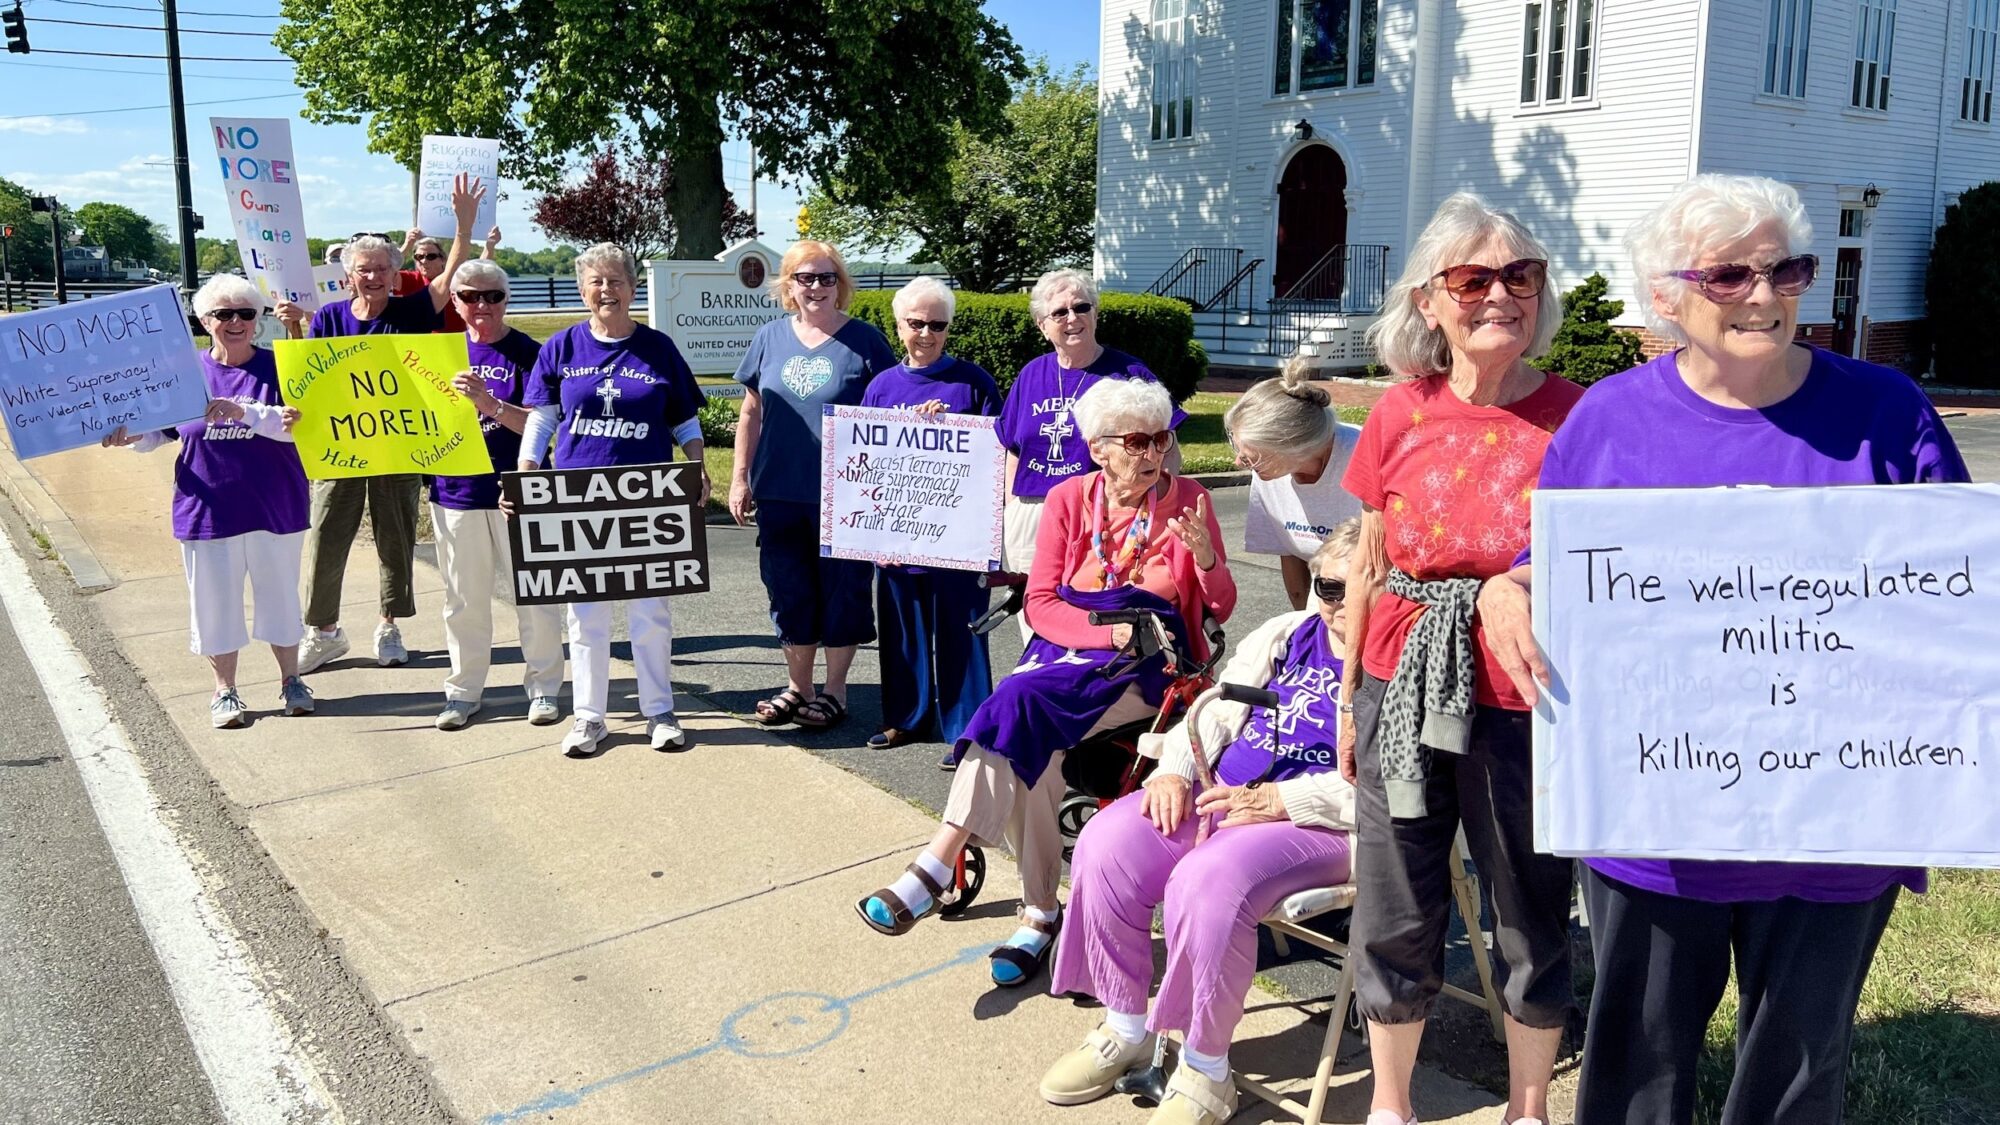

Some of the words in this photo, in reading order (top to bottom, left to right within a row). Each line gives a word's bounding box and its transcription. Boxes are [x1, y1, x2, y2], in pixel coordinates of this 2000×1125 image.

[215, 126, 259, 150] NO
[220, 157, 290, 184] MORE
[424, 180, 449, 189] GET
[240, 189, 280, 213] Guns
[244, 218, 292, 244] Hate
[251, 248, 284, 272] Lies
[256, 276, 313, 303] Raism
[17, 323, 66, 359] NO
[77, 304, 162, 348] MORE
[687, 341, 724, 349] UNITED
[2, 384, 59, 408] White
[66, 358, 157, 392] Supremacy!
[288, 370, 316, 400] Gun
[307, 341, 372, 374] Violence
[350, 369, 399, 399] NO
[403, 350, 460, 407] Racism
[469, 365, 516, 383] ERCY
[563, 366, 599, 379] Sisters
[603, 364, 616, 377] of
[619, 367, 656, 384] Mercy
[15, 413, 43, 428] Gun
[103, 387, 141, 405] Racist
[81, 417, 103, 435] No
[107, 406, 142, 424] more!
[1032, 397, 1076, 416] MER
[330, 409, 440, 441] MORE!!
[852, 423, 888, 445] NO
[896, 427, 970, 453] MORE
[320, 448, 369, 470] Hate
[411, 431, 464, 469] Violence
[856, 452, 912, 471] Racist
[846, 466, 885, 485] White
[887, 473, 959, 496] supremacy
[1027, 458, 1045, 473] for
[1046, 462, 1082, 477] Justice
[520, 468, 686, 505] BLACK
[871, 486, 903, 503] Gun
[906, 489, 963, 508] violence
[881, 502, 924, 519] Hate
[528, 513, 685, 553] LIVES
[849, 510, 885, 530] Truth
[890, 517, 947, 543] denying
[517, 559, 704, 598] MATTER
[1568, 547, 1666, 603] The
[1688, 555, 1975, 615] well-regulated
[1722, 615, 1854, 654] militia
[1278, 664, 1342, 704] MERC
[1770, 673, 1797, 706] is
[1252, 732, 1331, 765] Justice
[1639, 732, 1743, 790] Killing
[1759, 744, 1821, 772] our
[1838, 736, 1977, 771] Children.
